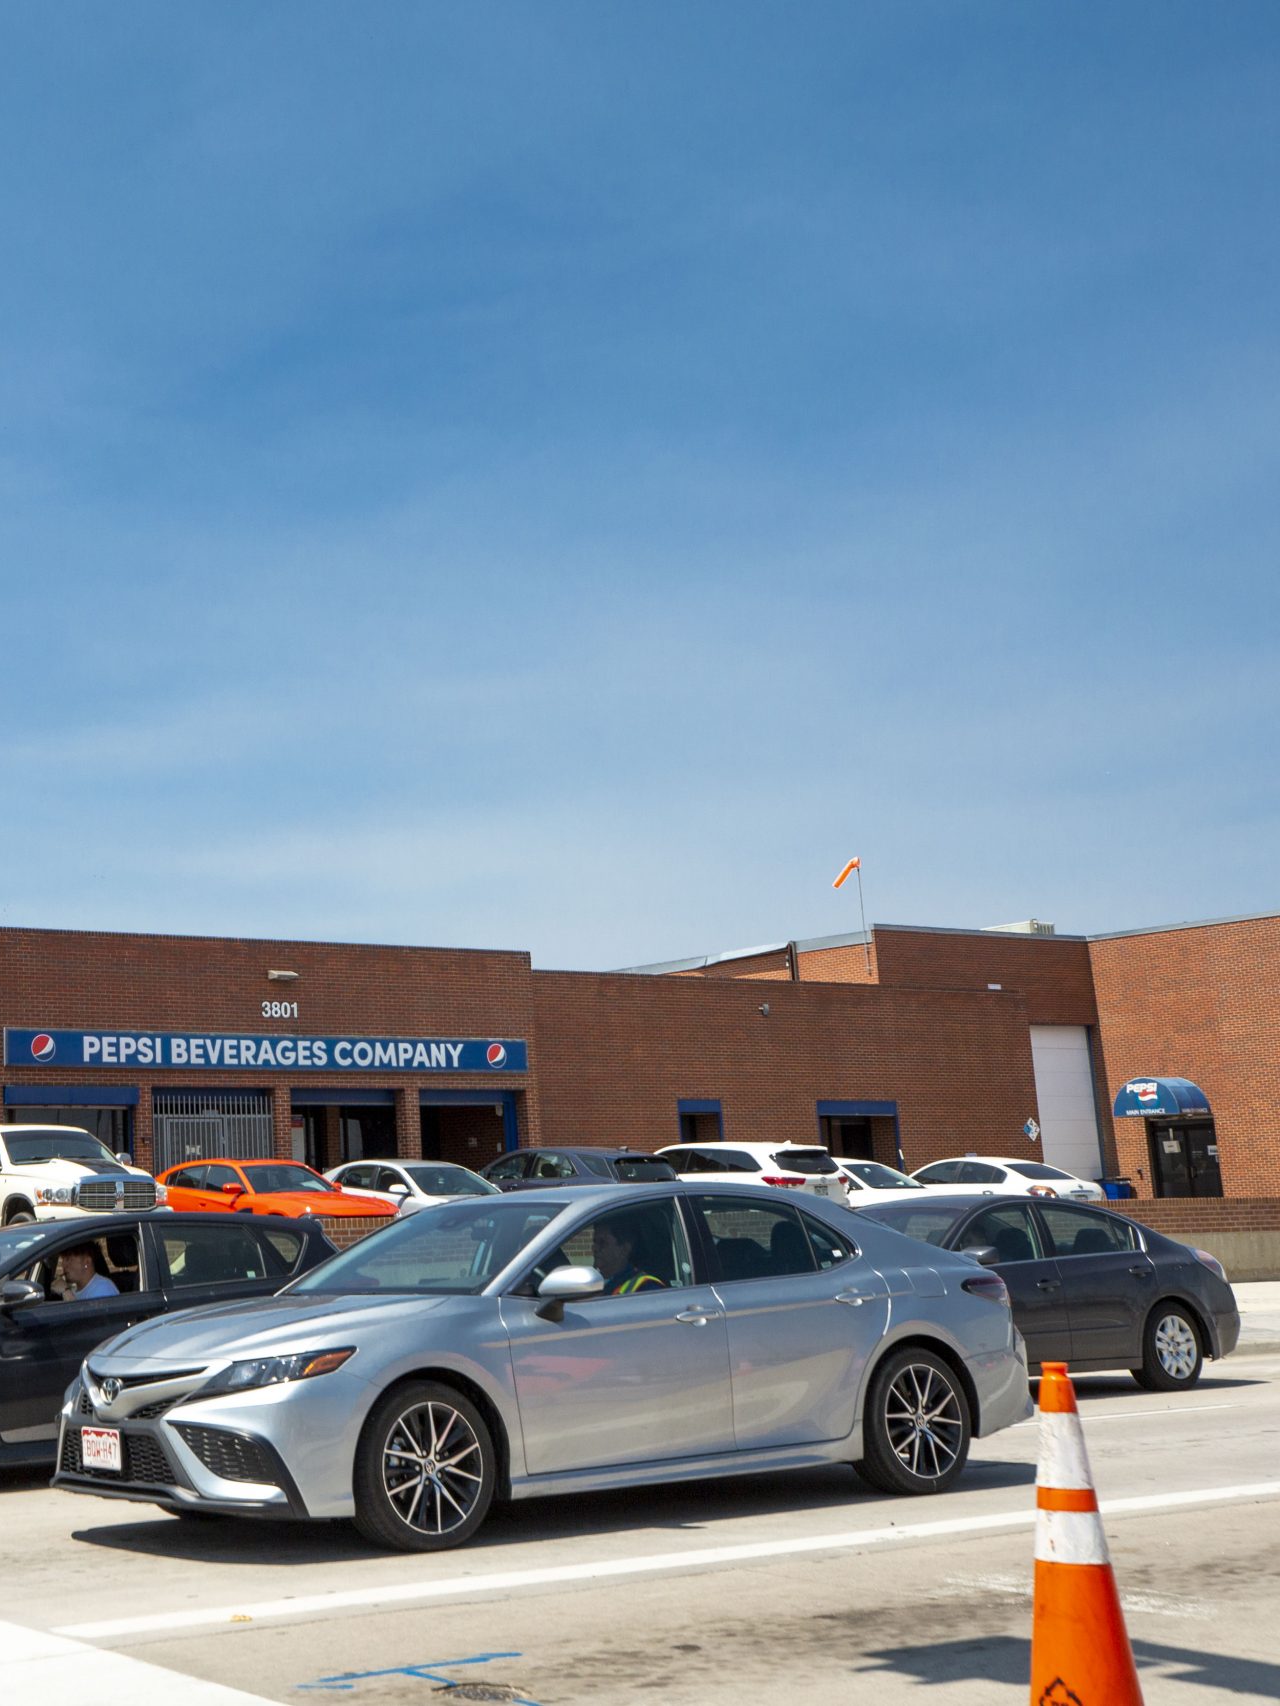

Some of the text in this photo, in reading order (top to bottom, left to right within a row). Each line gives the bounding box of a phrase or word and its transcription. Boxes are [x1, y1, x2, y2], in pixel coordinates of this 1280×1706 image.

[261, 1001, 298, 1018] 3801
[83, 1036, 464, 1067] PEPSI BEVERAGES COMPANY
[1126, 1083, 1157, 1093] PEPSI
